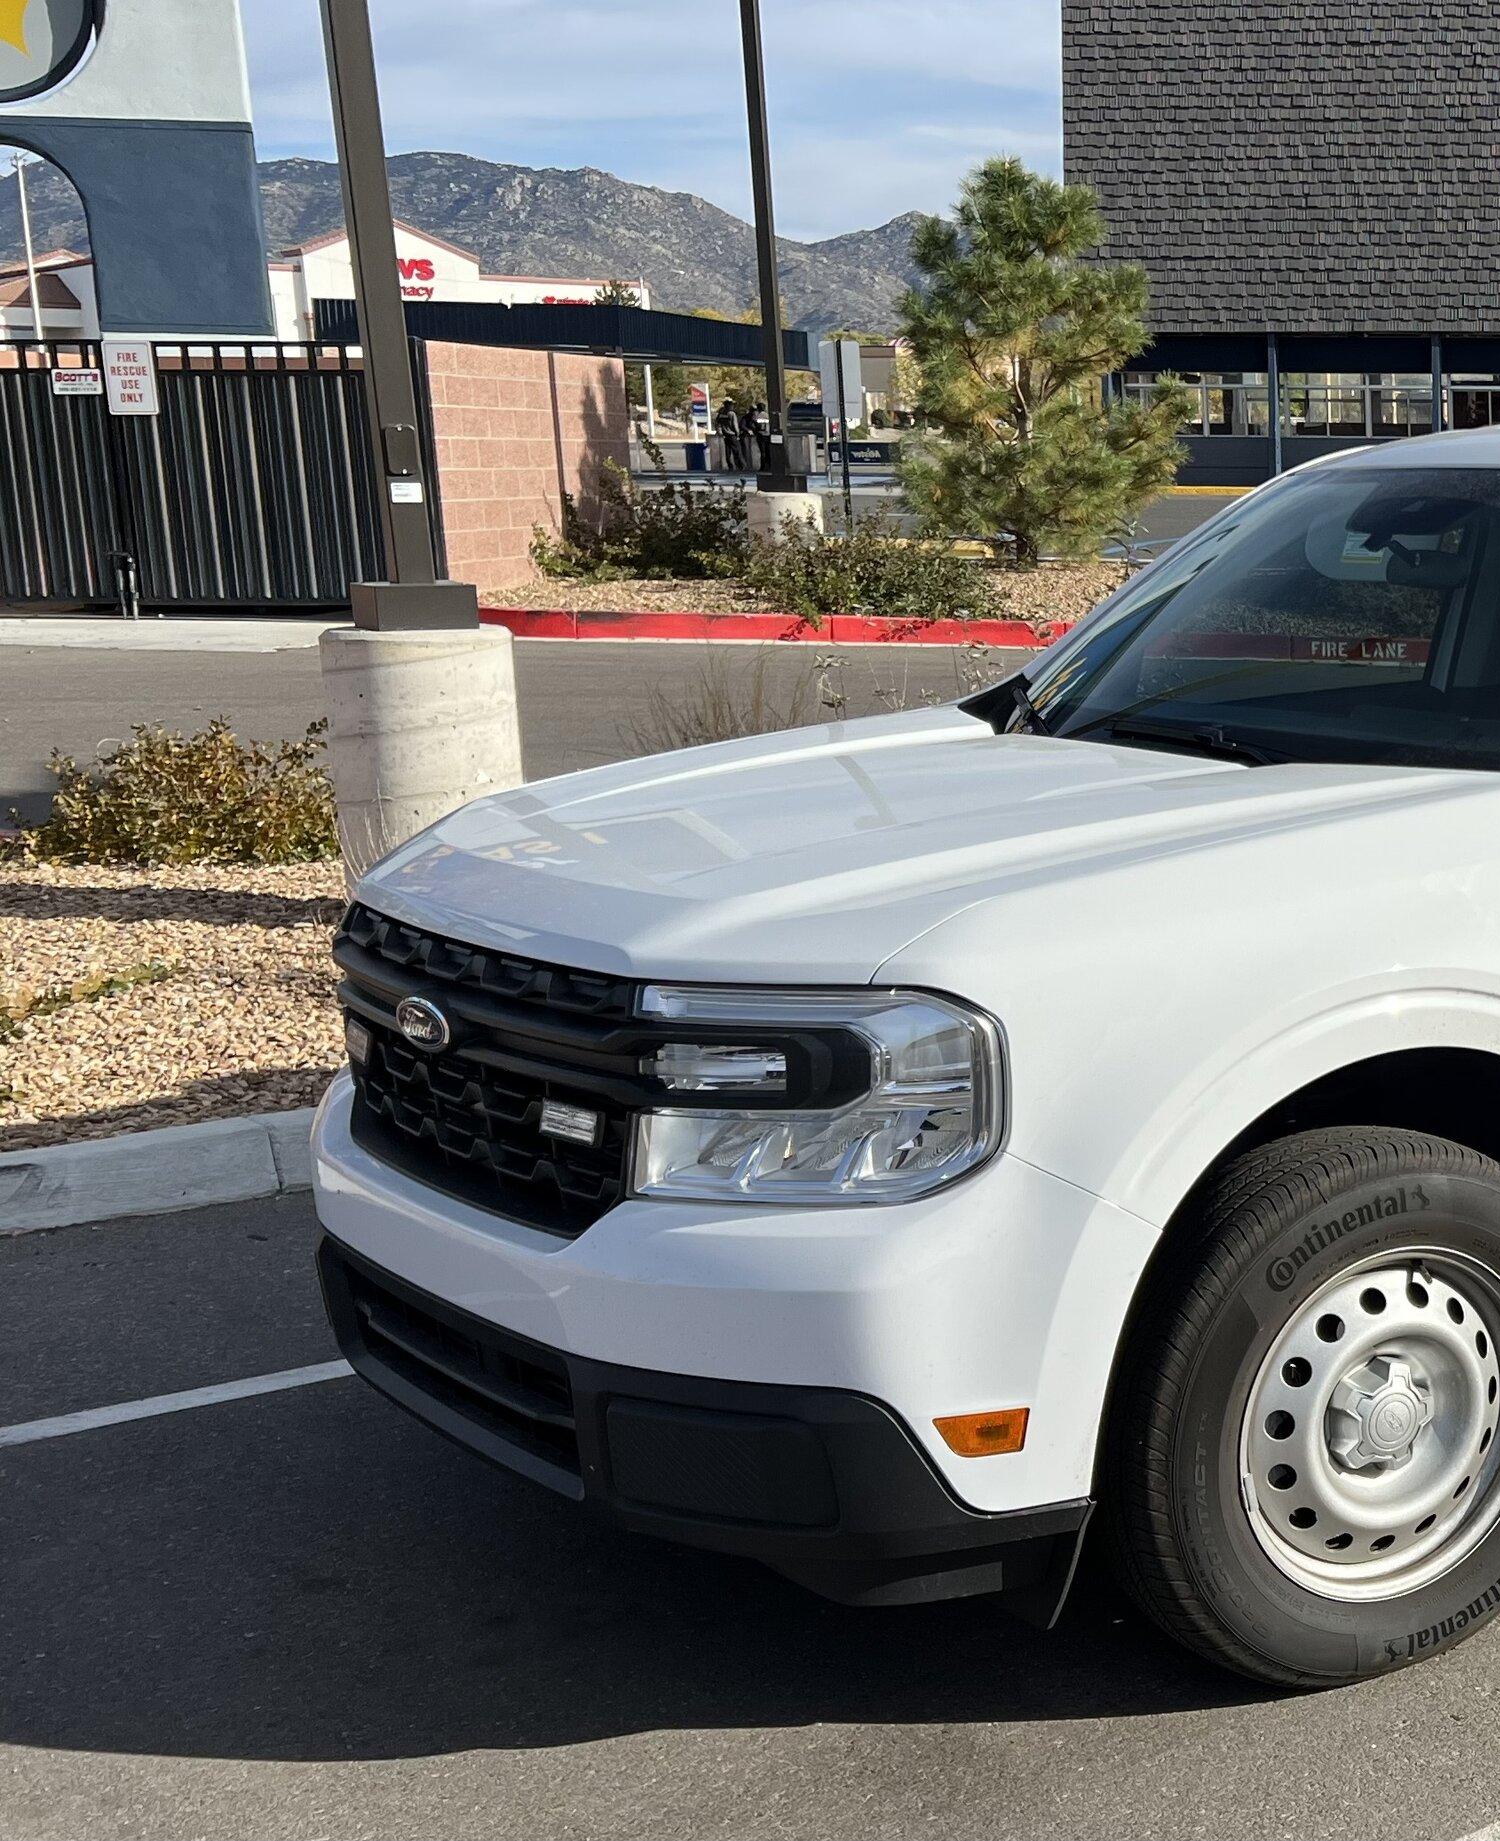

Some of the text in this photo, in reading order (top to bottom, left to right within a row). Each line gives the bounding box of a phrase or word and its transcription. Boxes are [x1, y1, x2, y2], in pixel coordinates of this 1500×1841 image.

[397, 258, 435, 281] VS
[116, 352, 139, 363] FIRE
[110, 366, 148, 376] RESCUE
[121, 379, 140, 390] USE
[120, 393, 144, 403] ONLY
[1310, 641, 1408, 659] FIRE LANE
[403, 1007, 434, 1040] Ford
[1265, 1187, 1408, 1293] Continental
